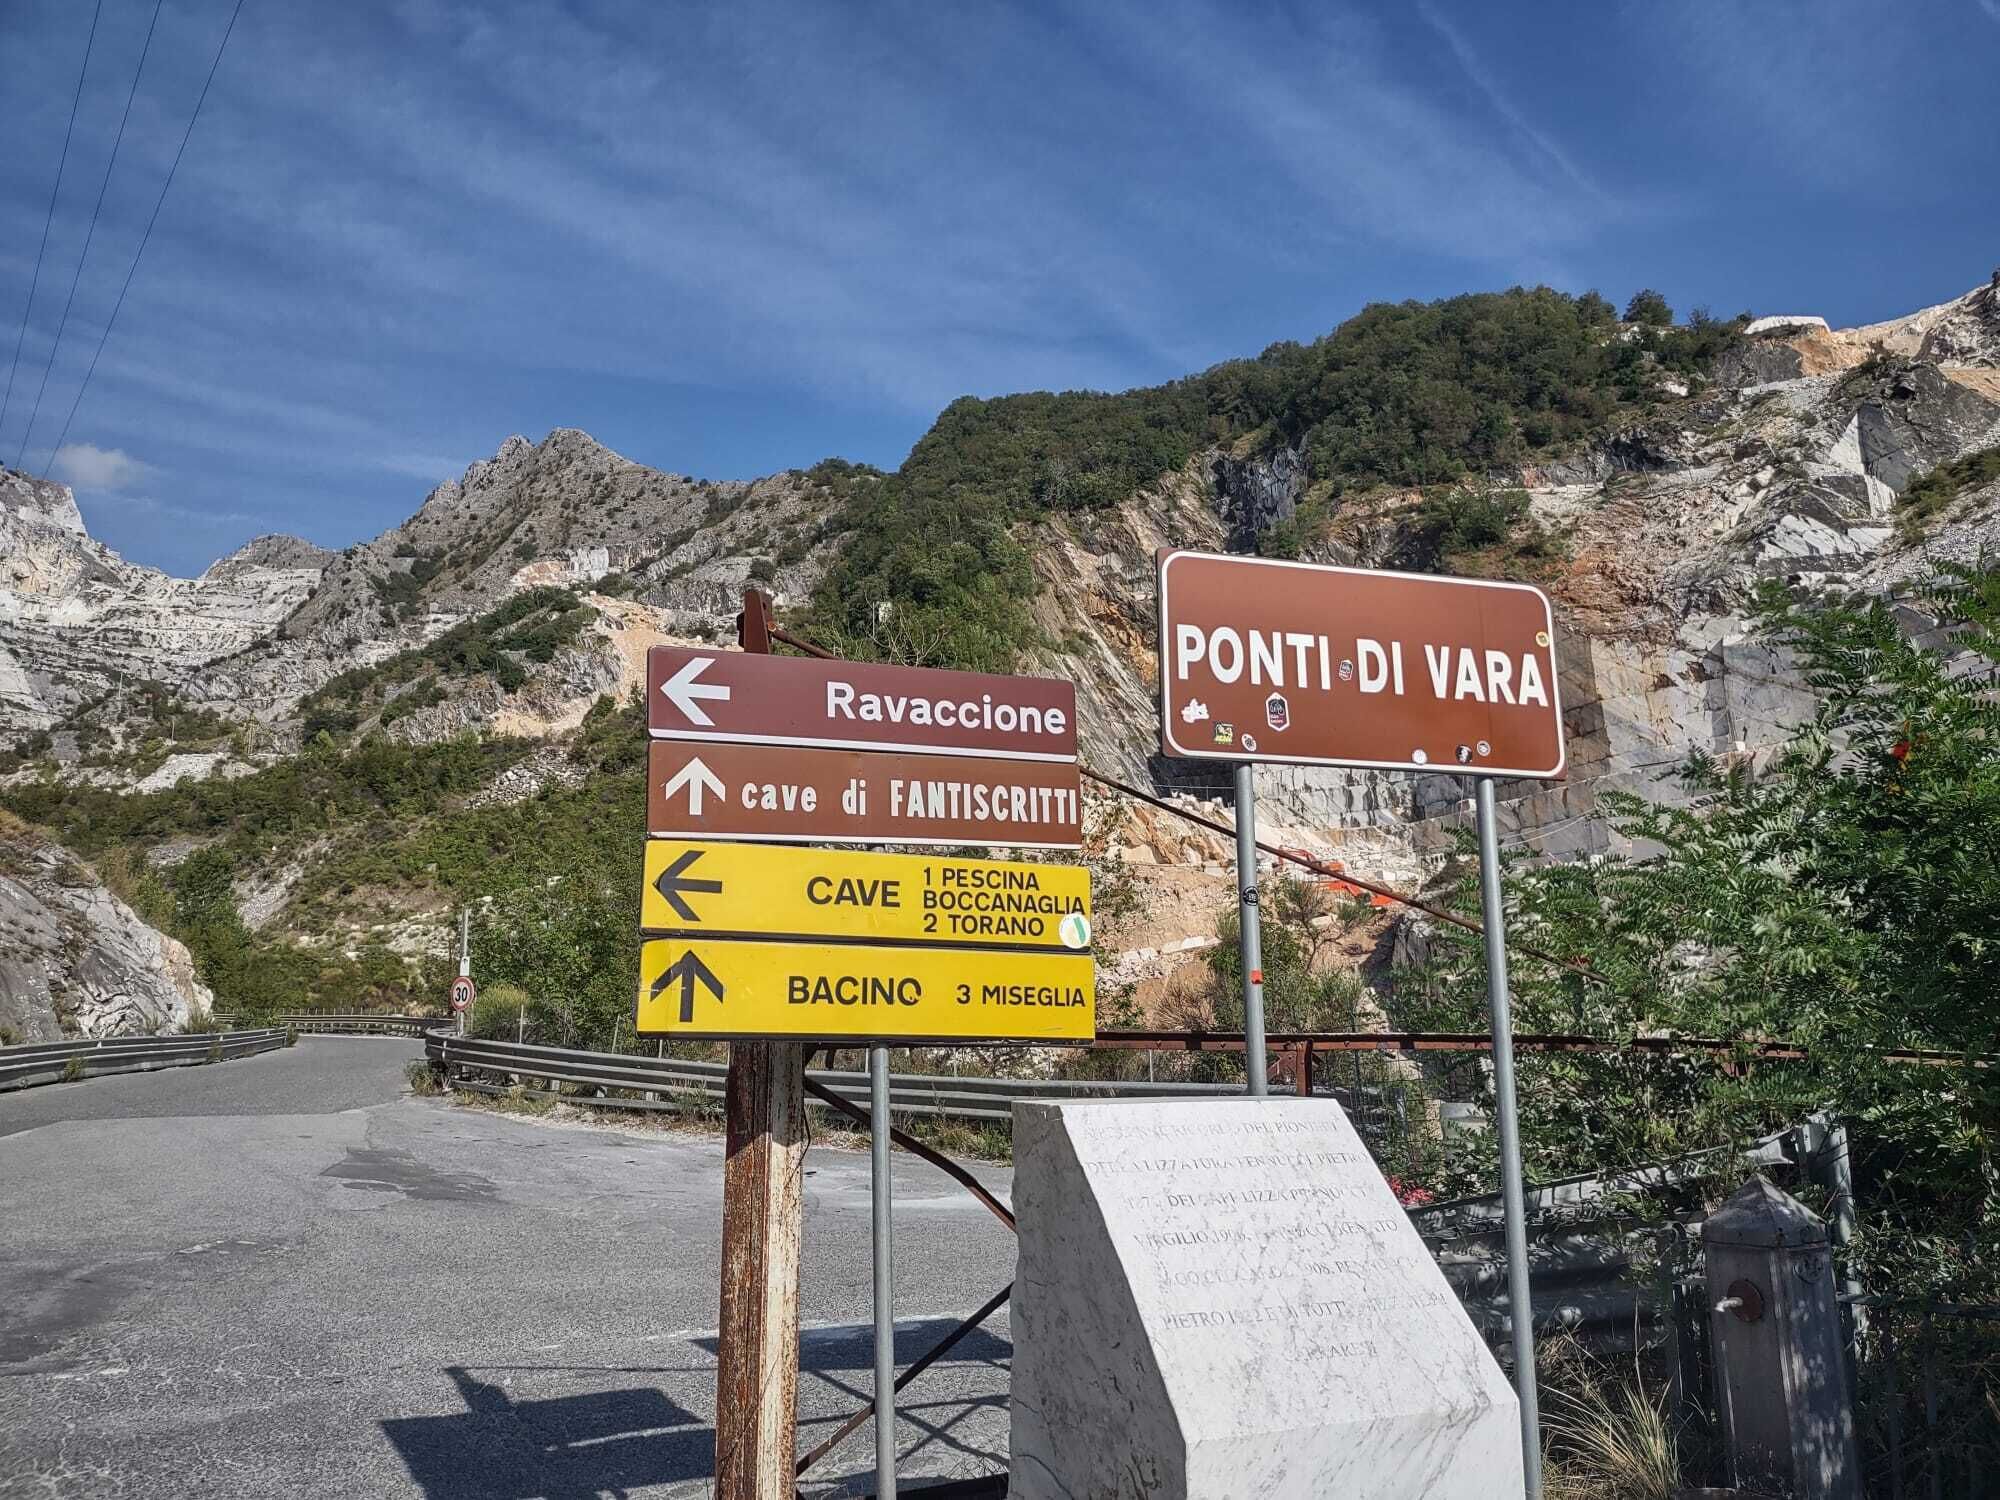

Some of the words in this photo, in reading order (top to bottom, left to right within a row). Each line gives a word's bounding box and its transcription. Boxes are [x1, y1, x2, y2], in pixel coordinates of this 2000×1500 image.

[1176, 624, 1331, 690] PONTI
[1356, 638, 1404, 695] DI
[1424, 644, 1549, 707] VARA
[826, 680, 1066, 735] Ravaccione
[741, 781, 817, 812] cave
[842, 778, 866, 815] di
[890, 779, 1078, 824] FANTISCRITTI
[807, 876, 901, 908] CAVE
[923, 867, 931, 886] 1
[942, 868, 1040, 891] PESCINA
[923, 889, 1086, 915] BOCCANAGLIA
[923, 913, 938, 933] 2
[950, 914, 1045, 936] TORANO
[455, 986, 468, 1002] 30
[789, 975, 922, 1006] BACINO
[956, 984, 971, 1004] 3
[982, 985, 1086, 1007] MISEGLIA
